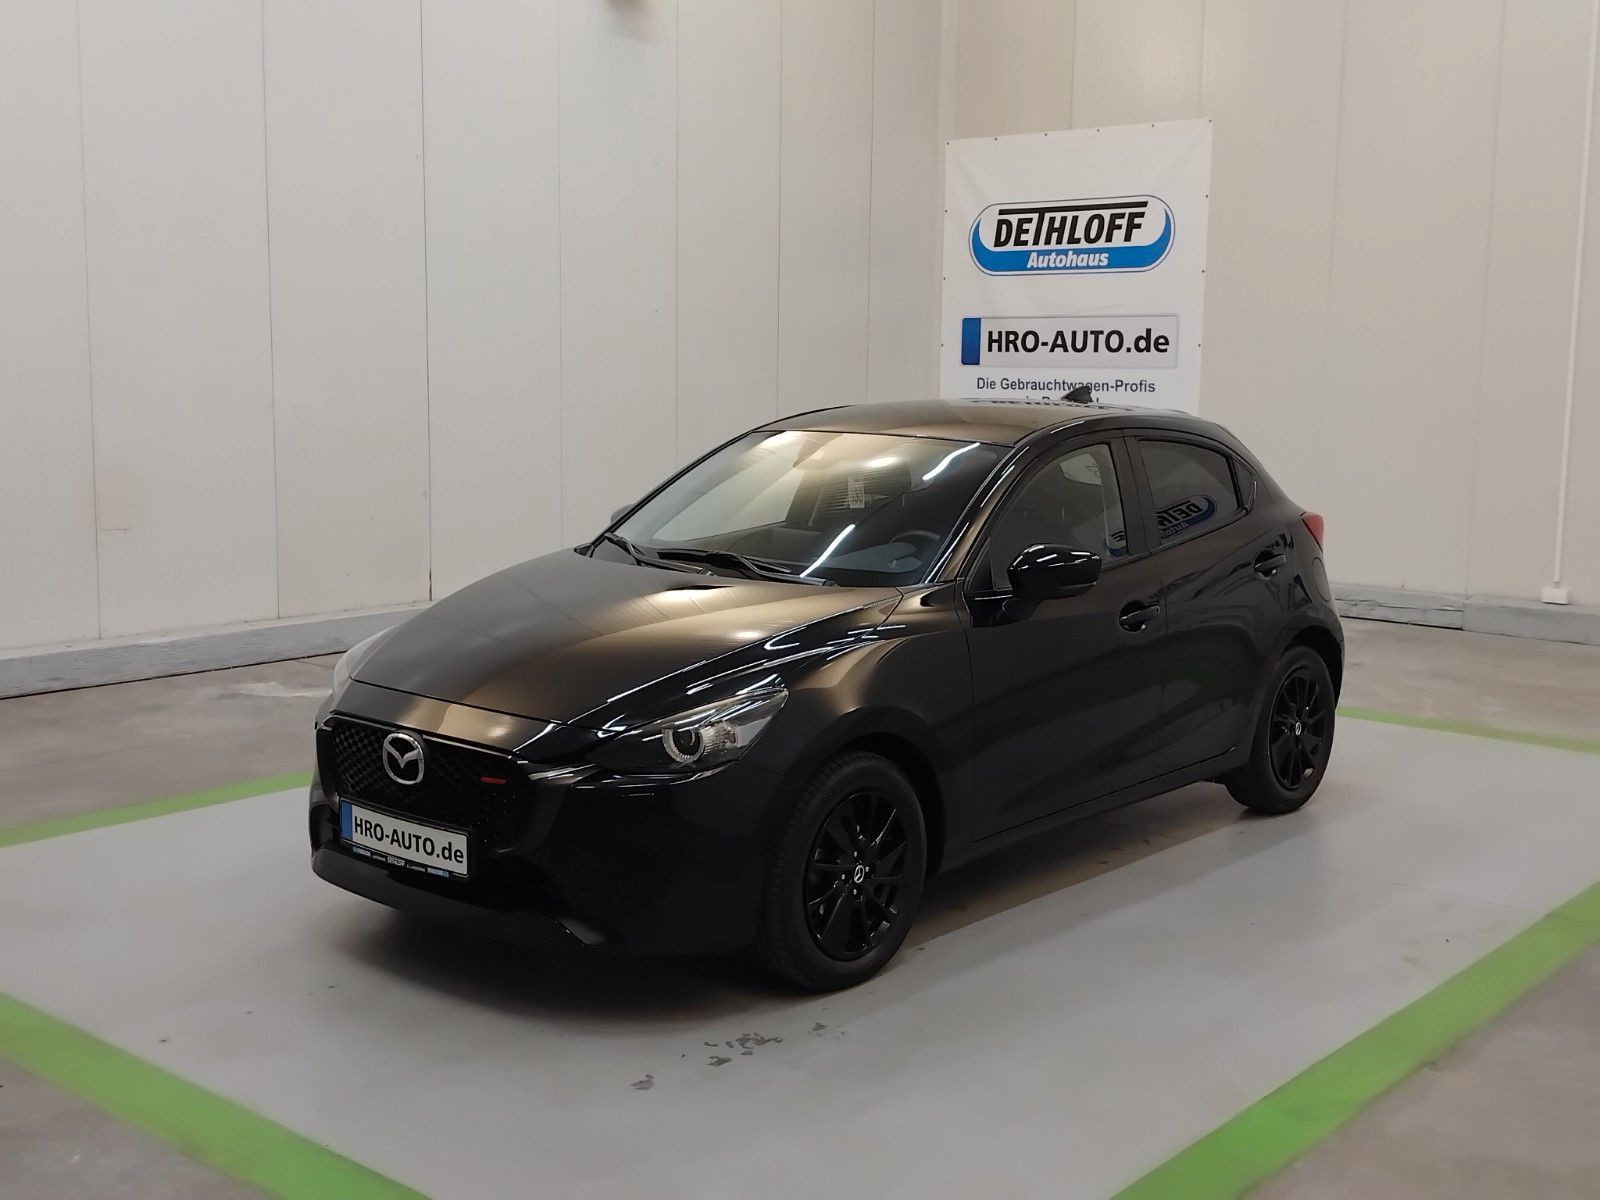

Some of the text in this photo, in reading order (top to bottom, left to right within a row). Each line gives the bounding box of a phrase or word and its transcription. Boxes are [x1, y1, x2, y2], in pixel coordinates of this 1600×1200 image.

[993, 201, 1149, 248] DETHLOFF
[1026, 251, 1109, 269] Autohaus
[987, 328, 1170, 354] HRO-AUTO.de
[976, 377, 997, 390] Die
[354, 815, 464, 864] HRO-AUTO.de
